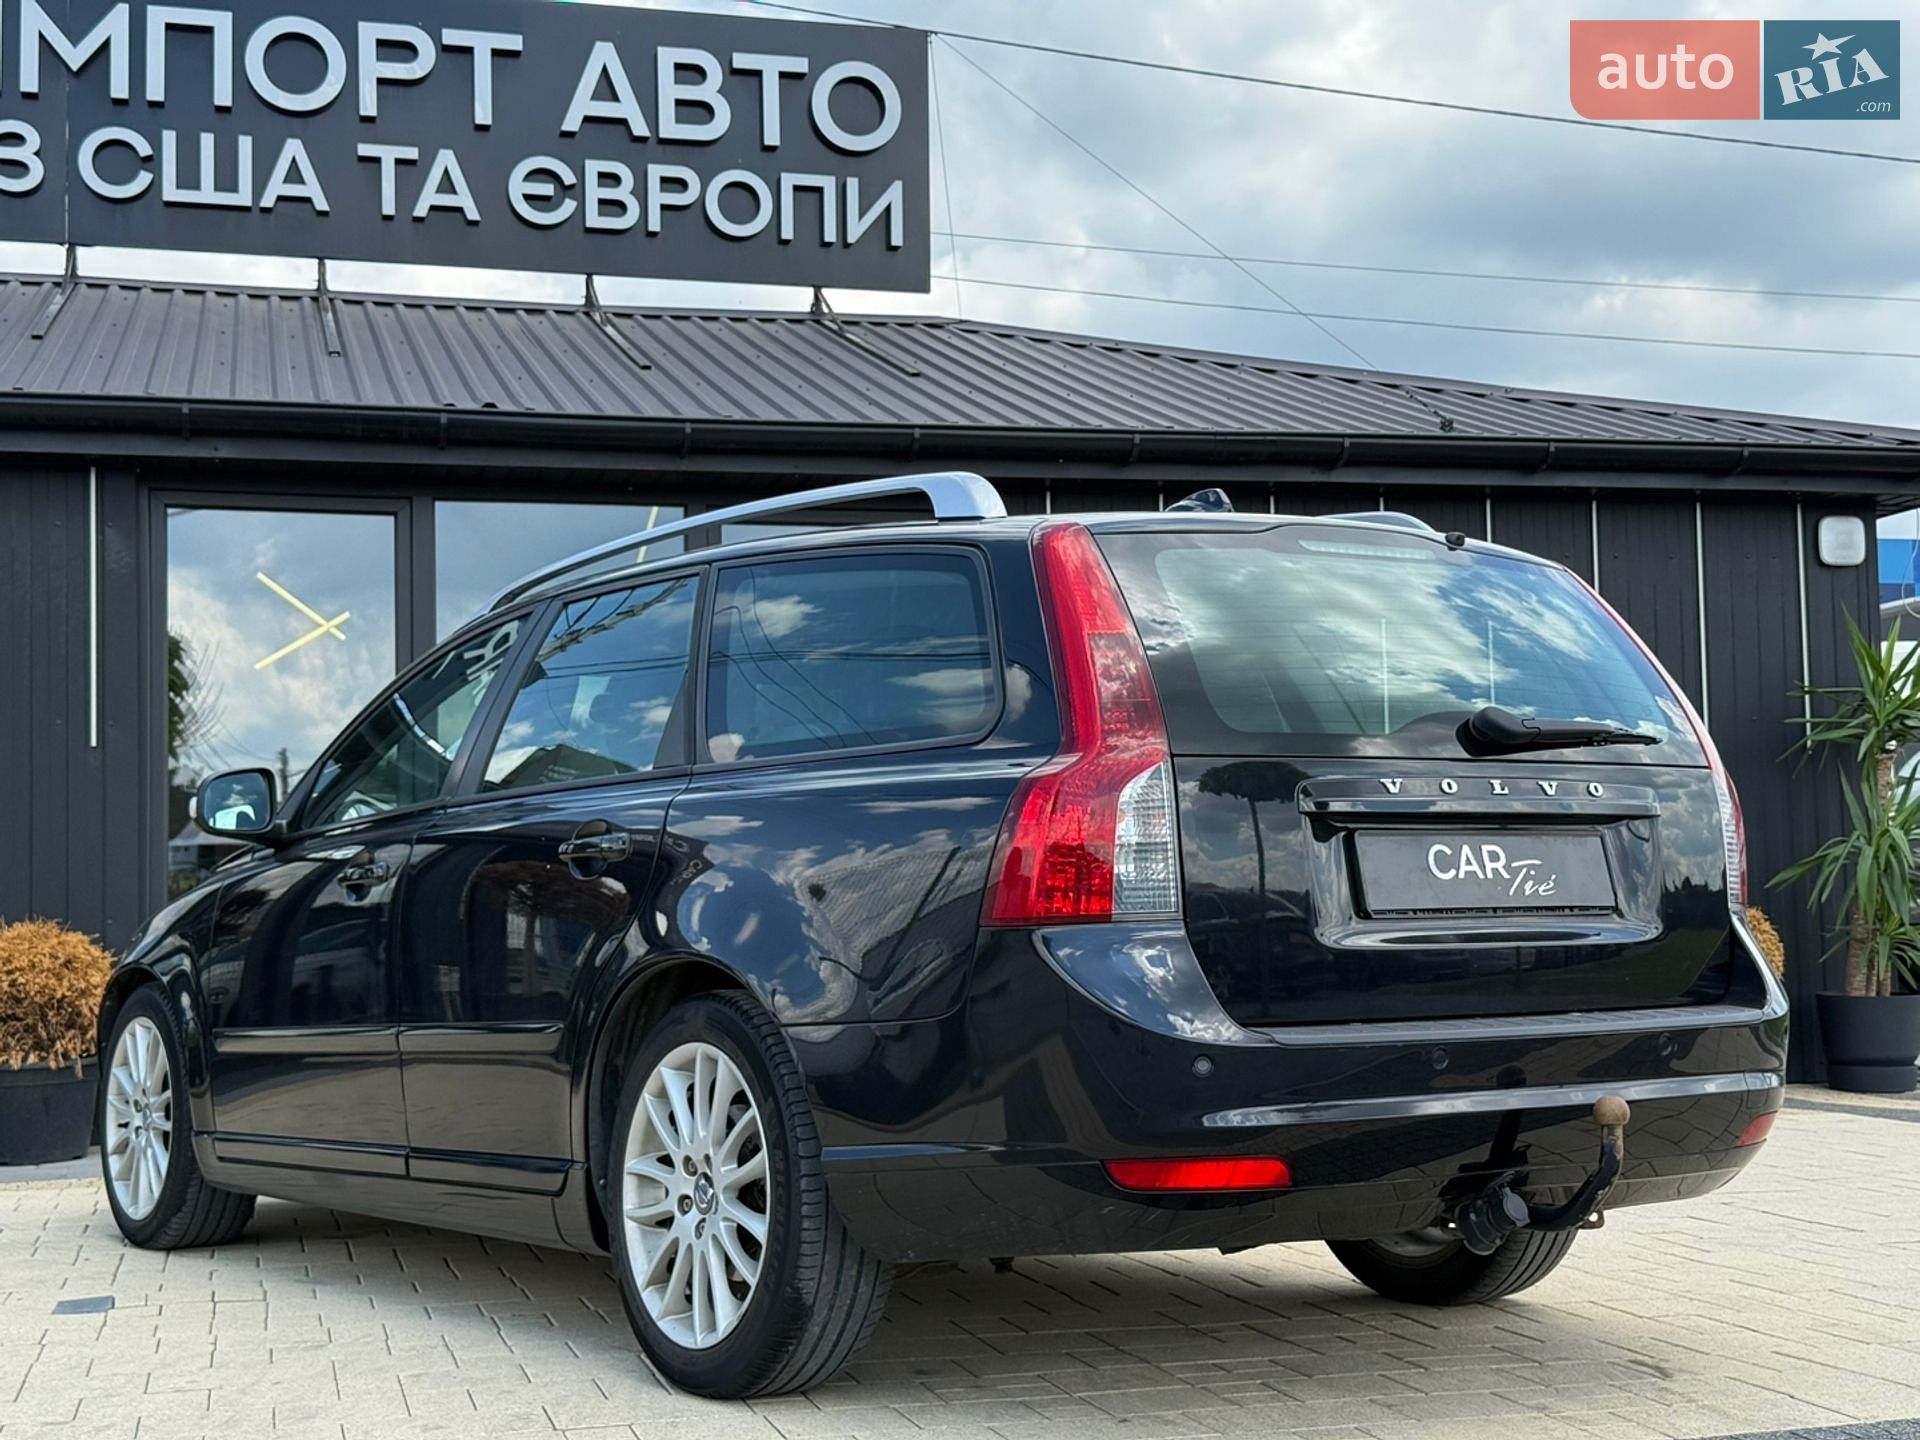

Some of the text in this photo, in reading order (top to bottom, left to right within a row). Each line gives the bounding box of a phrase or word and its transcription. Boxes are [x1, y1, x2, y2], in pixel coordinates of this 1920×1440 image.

[0, 0, 902, 152] МПОРТ АВТО
[77, 126, 331, 212] США
[357, 143, 482, 222] ТА
[508, 155, 904, 248] ЄВРОПИ
[1379, 777, 1605, 797] VOLVO
[1427, 843, 1511, 880] CAR
